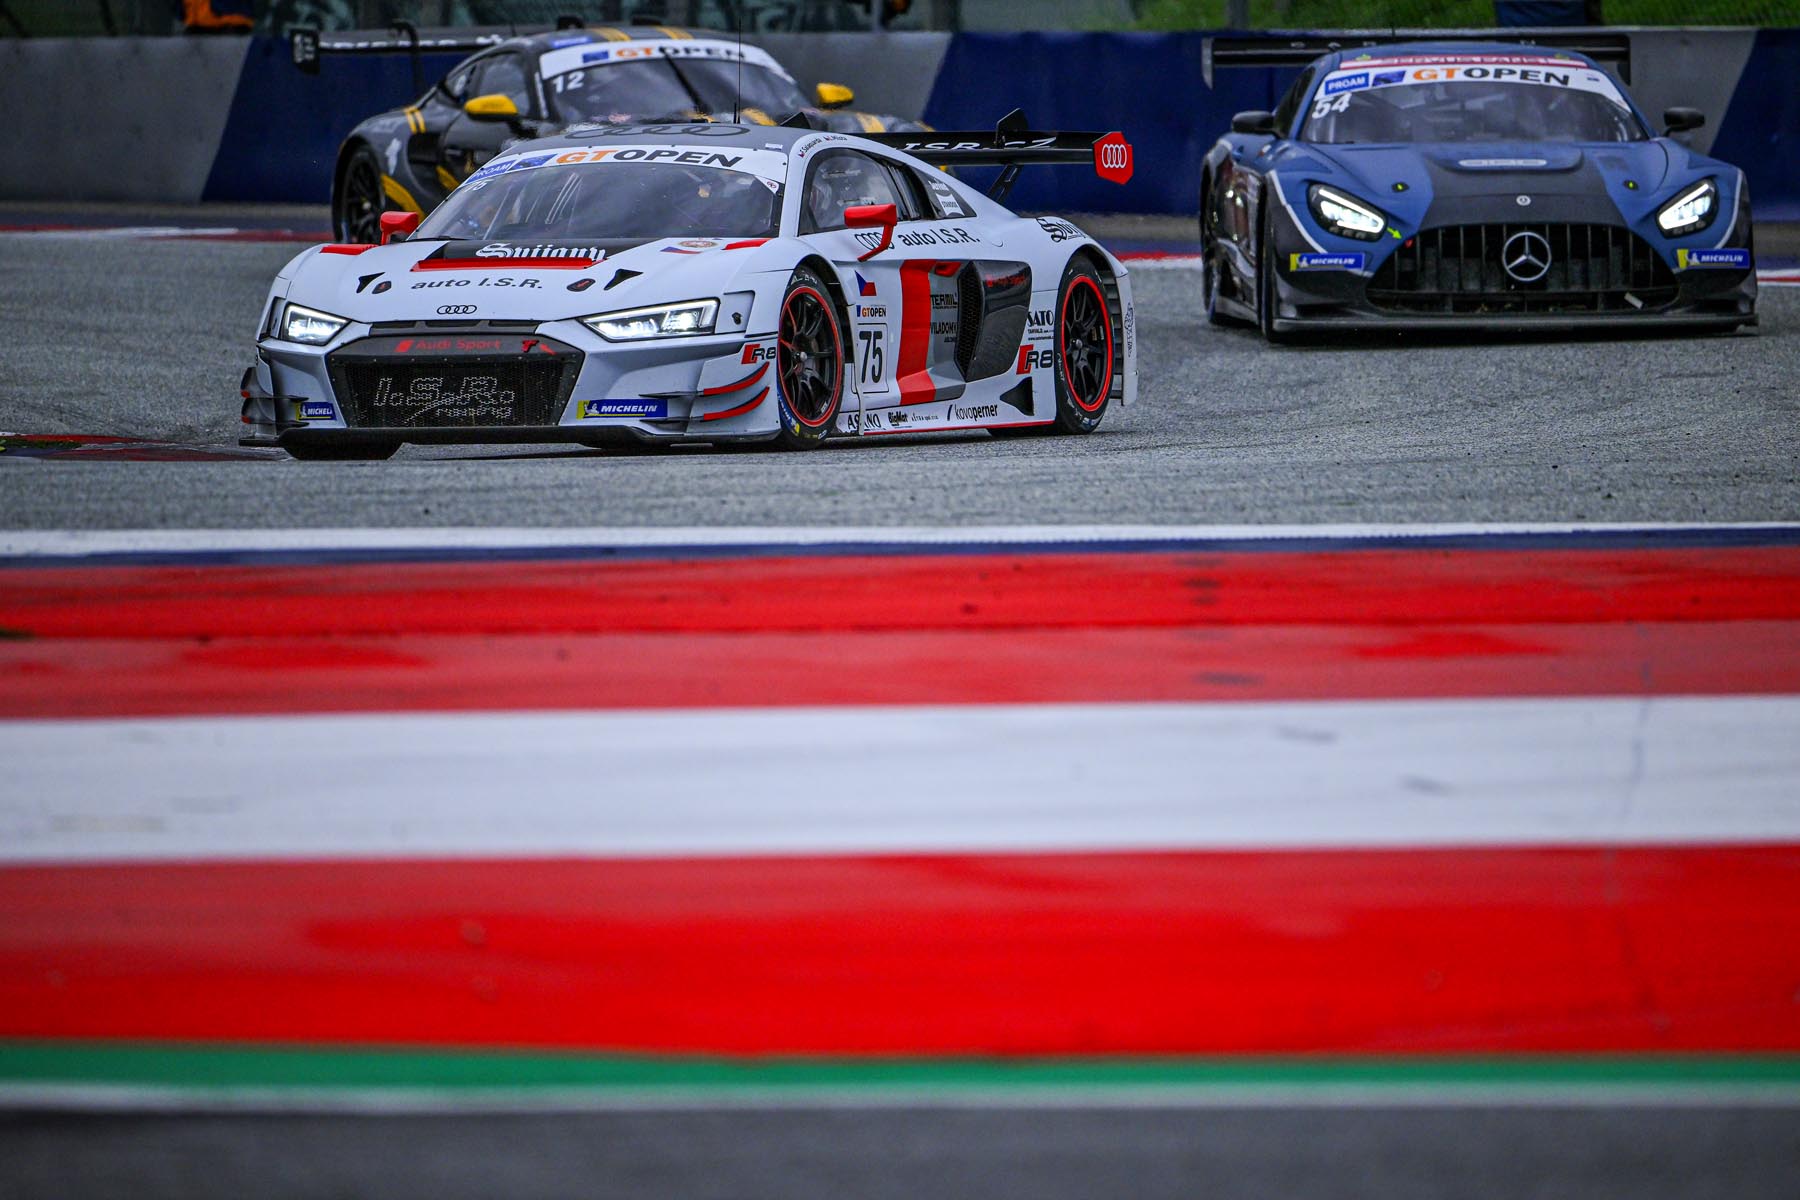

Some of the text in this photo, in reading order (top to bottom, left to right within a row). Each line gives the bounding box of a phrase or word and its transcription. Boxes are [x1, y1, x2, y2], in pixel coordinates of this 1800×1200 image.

[553, 71, 585, 93] 12
[1328, 76, 1365, 91] PROAM
[1413, 67, 1570, 86] GTOPEN
[1312, 92, 1352, 119] 54
[556, 149, 743, 167] GTOPEN
[898, 231, 937, 246] auto
[1310, 257, 1356, 265] MICHELIN
[1701, 254, 1744, 262] MICHELIN
[411, 277, 543, 290] auto I.S.R.
[1027, 310, 1054, 327] SATO
[416, 340, 501, 351] Audi Sport
[859, 331, 883, 384] 75
[1024, 350, 1054, 369] R8
[601, 405, 657, 413] MICHELIN
[955, 404, 998, 422] kovoperner
